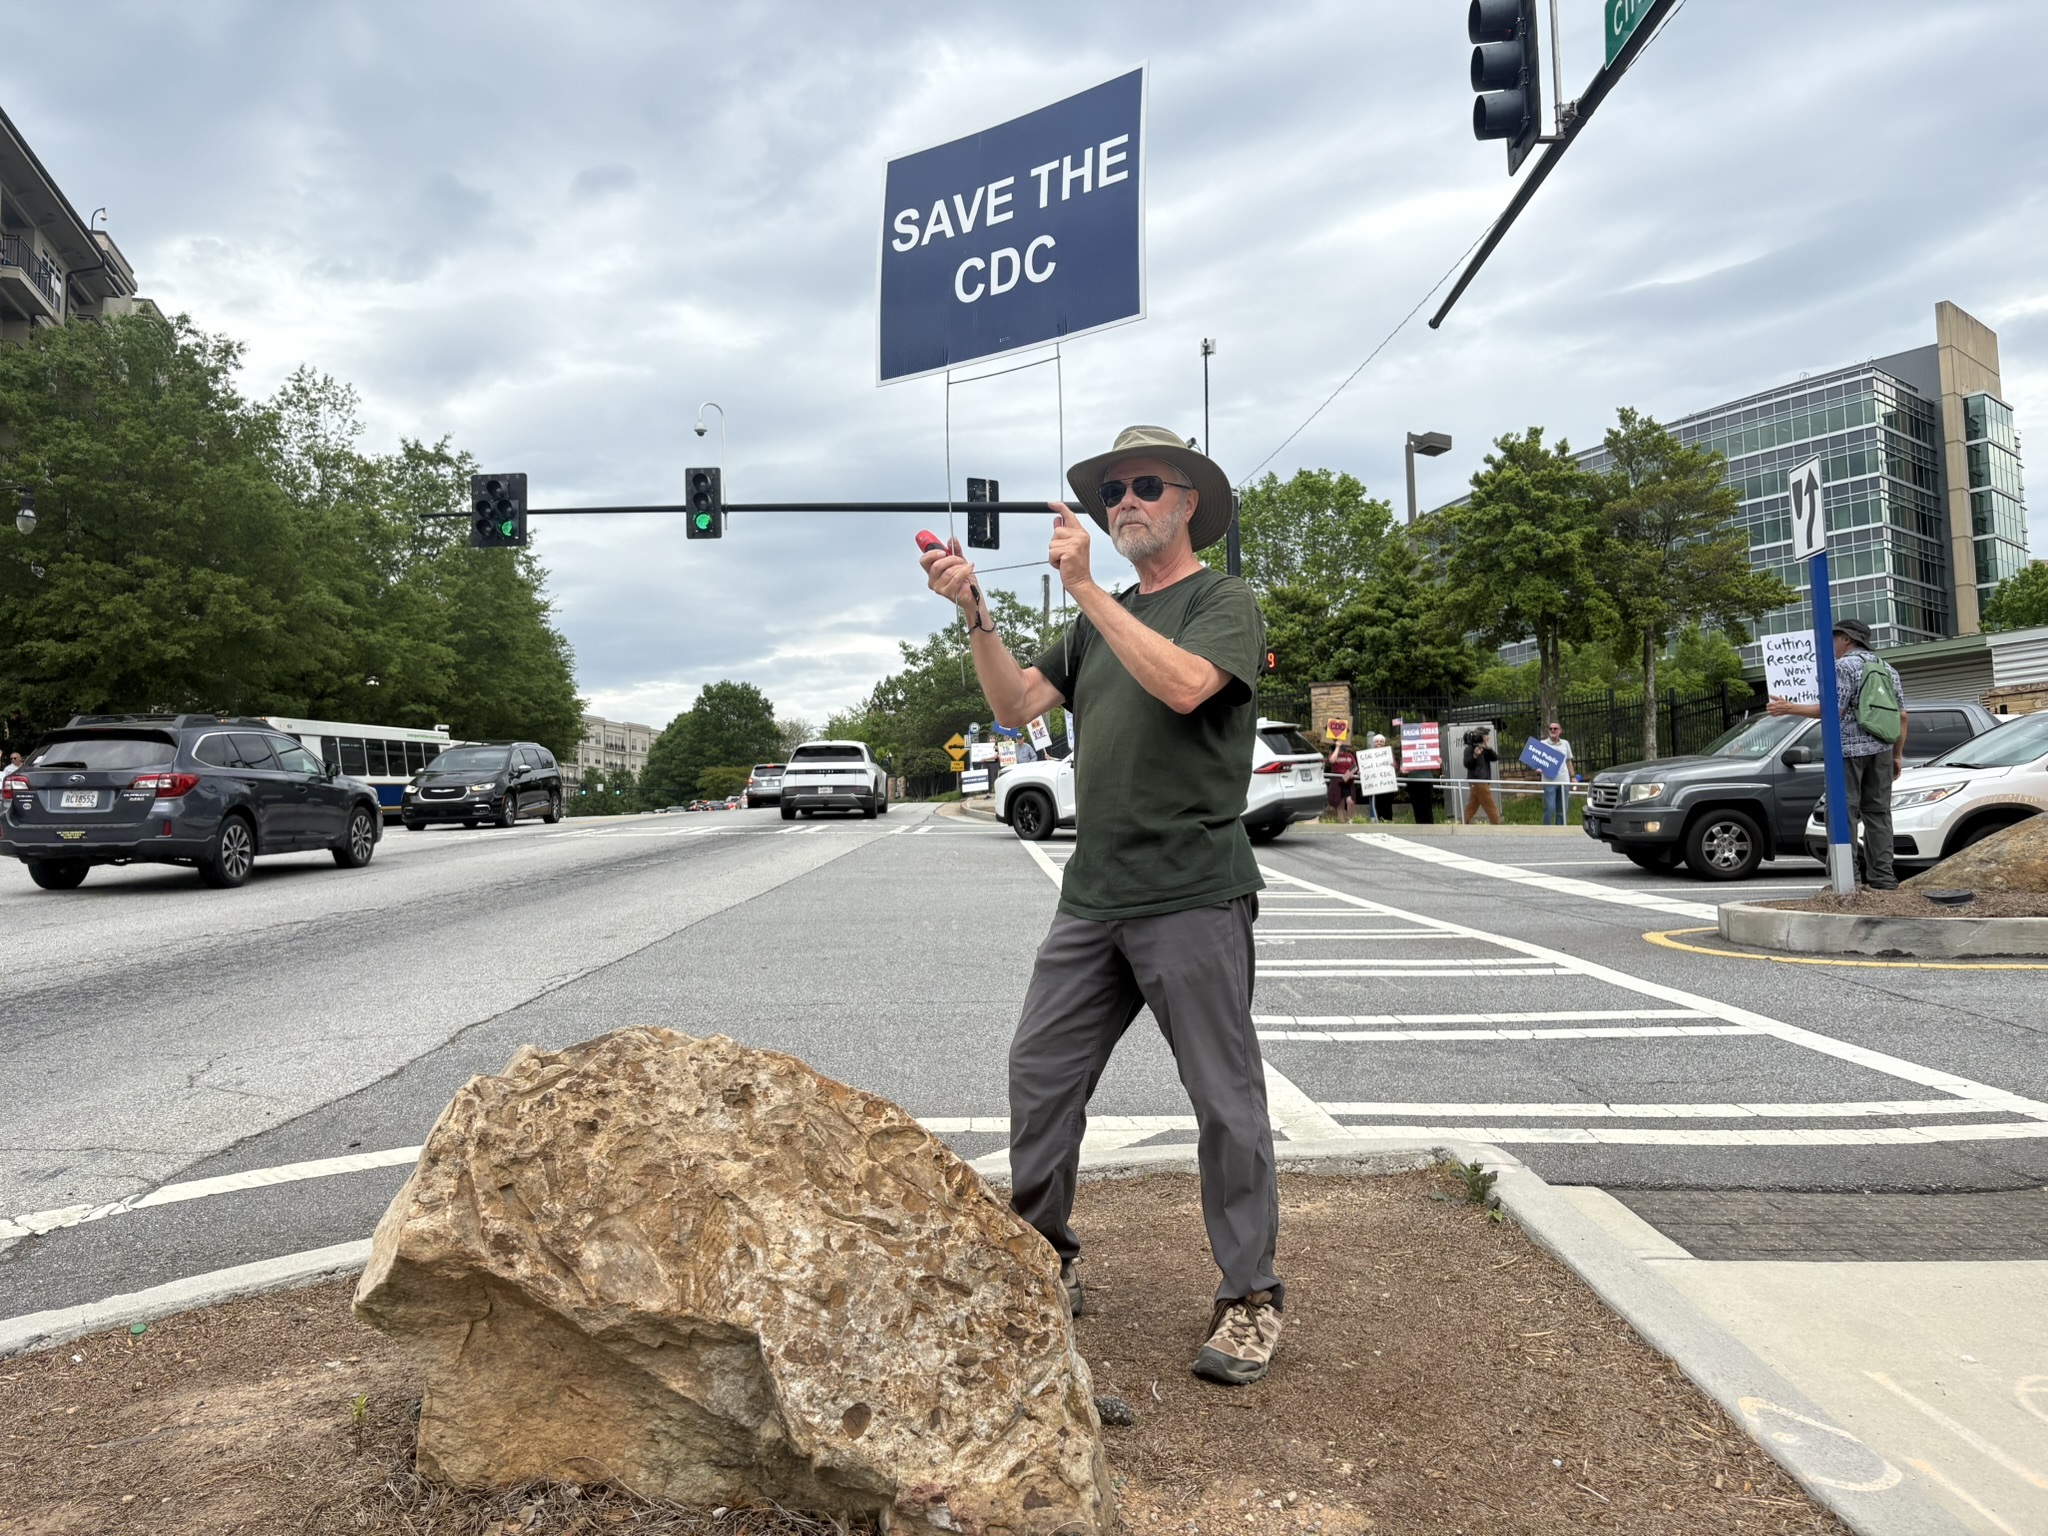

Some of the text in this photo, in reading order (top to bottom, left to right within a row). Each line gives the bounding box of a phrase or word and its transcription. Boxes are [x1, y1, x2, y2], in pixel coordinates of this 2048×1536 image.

[892, 133, 1128, 252] SAVE THE
[955, 235, 1056, 303] CDC
[1767, 637, 1812, 653] Cutting
[1267, 652, 1275, 668] 9
[1767, 652, 1816, 666] Researc
[1772, 677, 1807, 688] make
[1331, 722, 1346, 731] CDC
[1528, 744, 1559, 765] Save Public
[1531, 754, 1549, 768] Health
